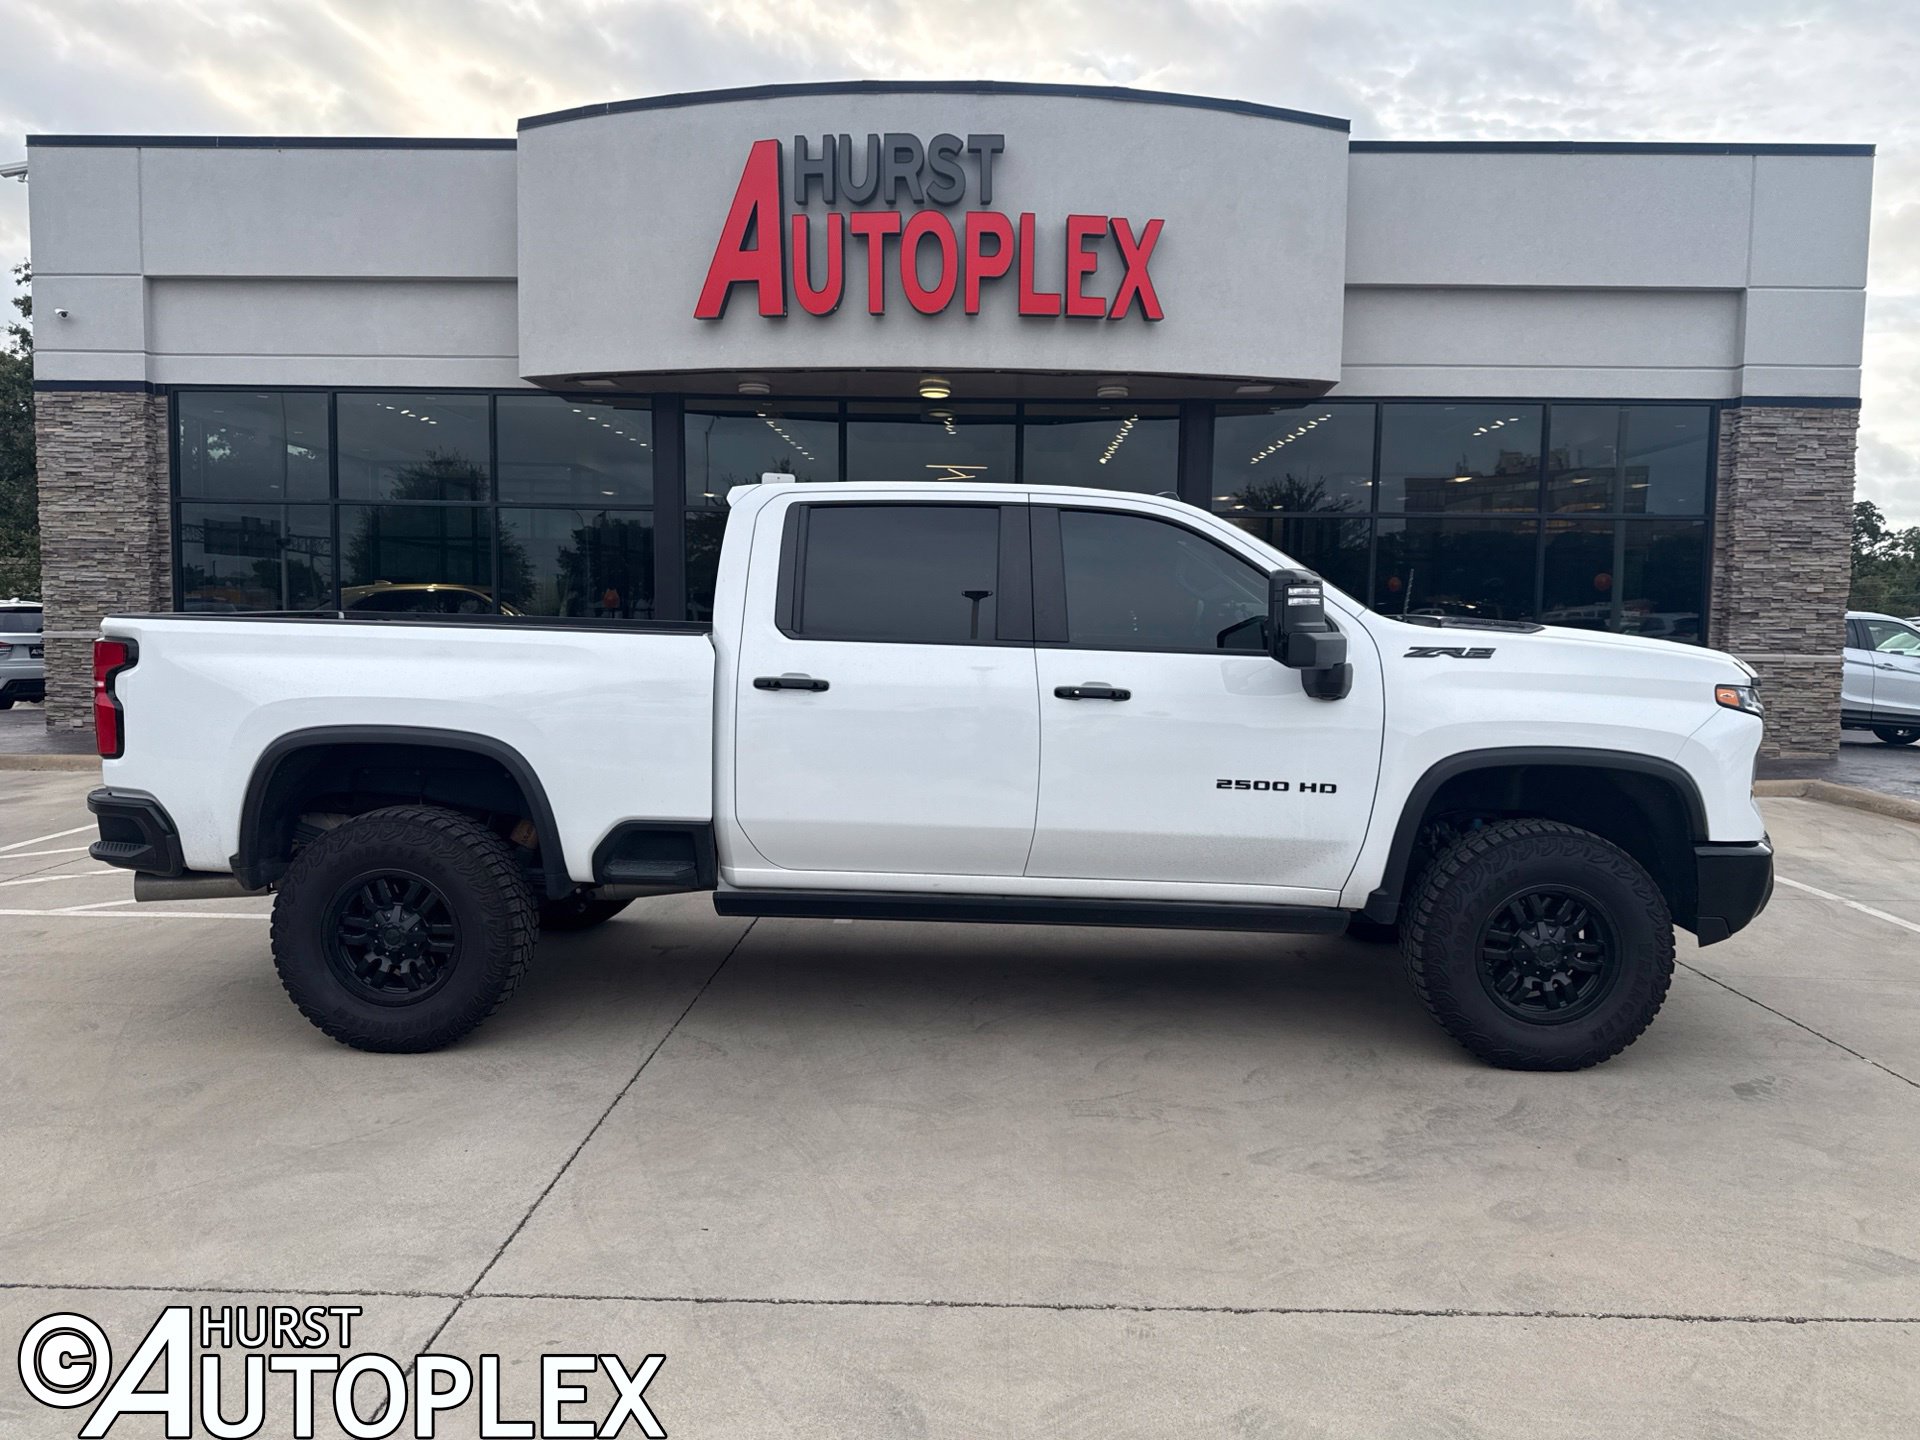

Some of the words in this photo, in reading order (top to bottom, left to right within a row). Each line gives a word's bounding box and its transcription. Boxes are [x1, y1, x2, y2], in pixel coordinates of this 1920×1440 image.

[794, 133, 1005, 205] HURST
[693, 139, 1165, 320] AUTOPLEX
[1403, 646, 1496, 659] ZR2
[1216, 779, 1289, 792] 2500
[1299, 782, 1337, 794] HD
